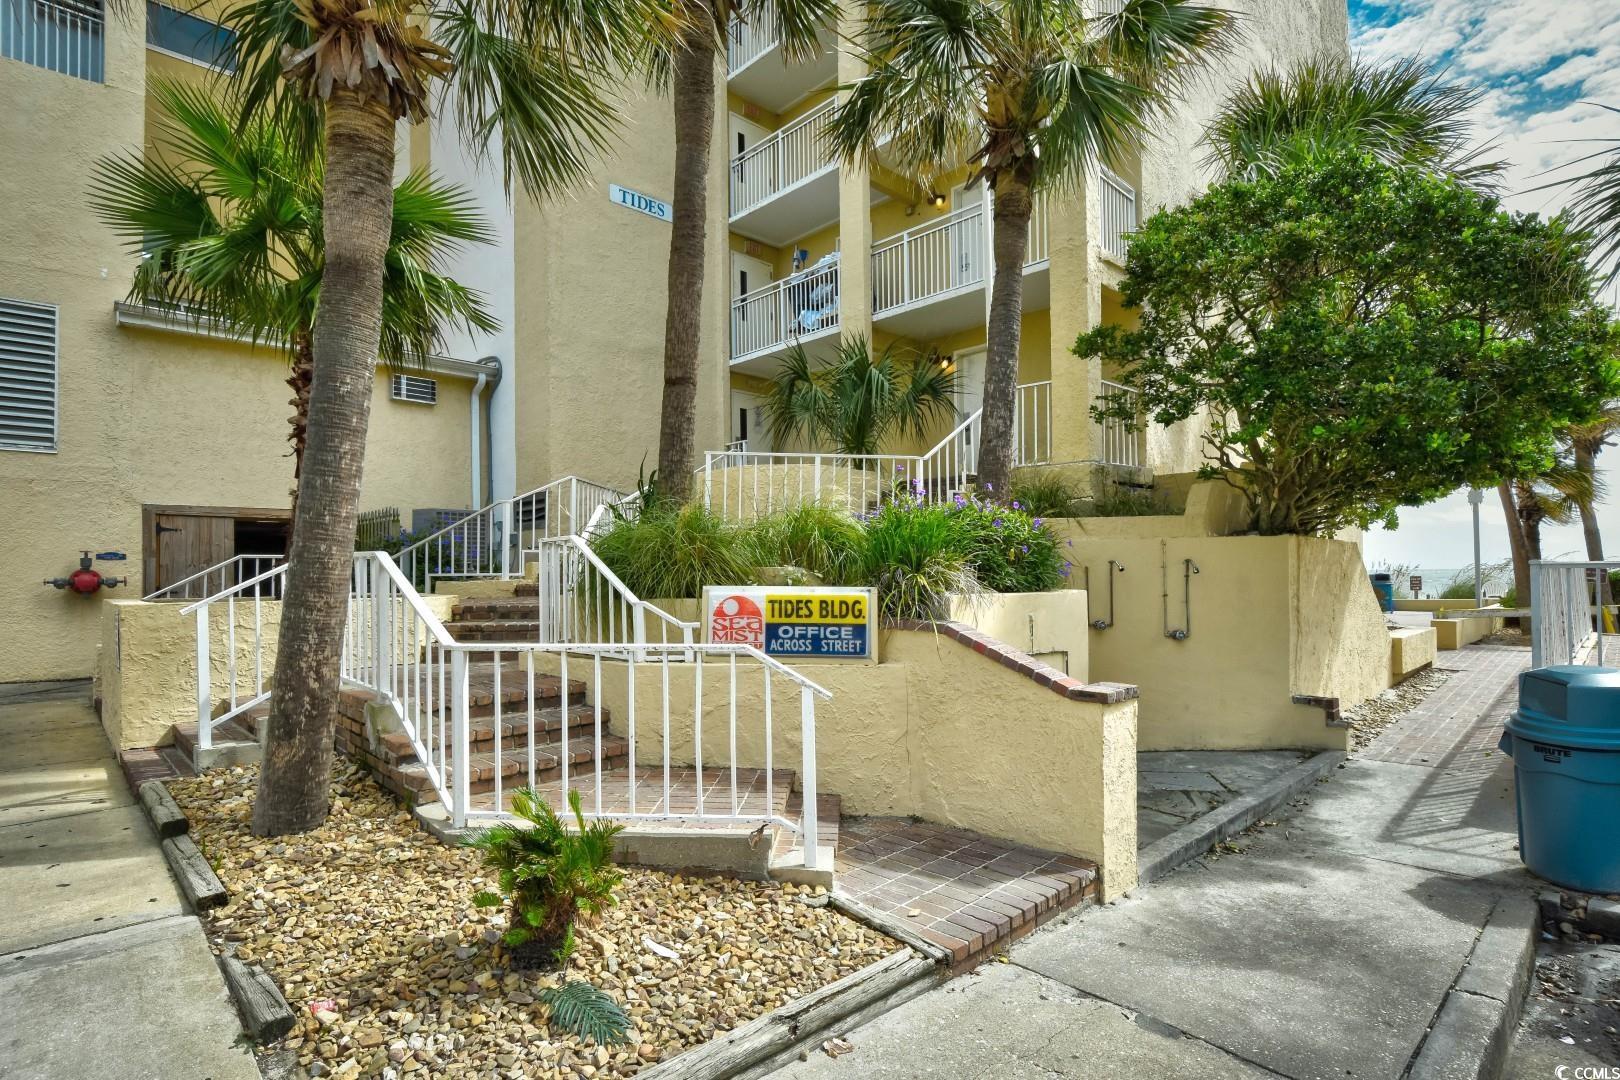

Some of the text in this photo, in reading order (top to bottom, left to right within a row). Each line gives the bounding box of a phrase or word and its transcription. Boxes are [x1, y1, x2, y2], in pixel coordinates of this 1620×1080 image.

[618, 188, 665, 217] TIDES
[767, 599, 866, 620] TIDES BLDG.
[712, 630, 763, 642] MIST
[778, 625, 853, 639] OFFICE
[770, 639, 812, 652] ACROSS
[821, 640, 862, 653] STREET
[1534, 744, 1572, 758] BRUTE
